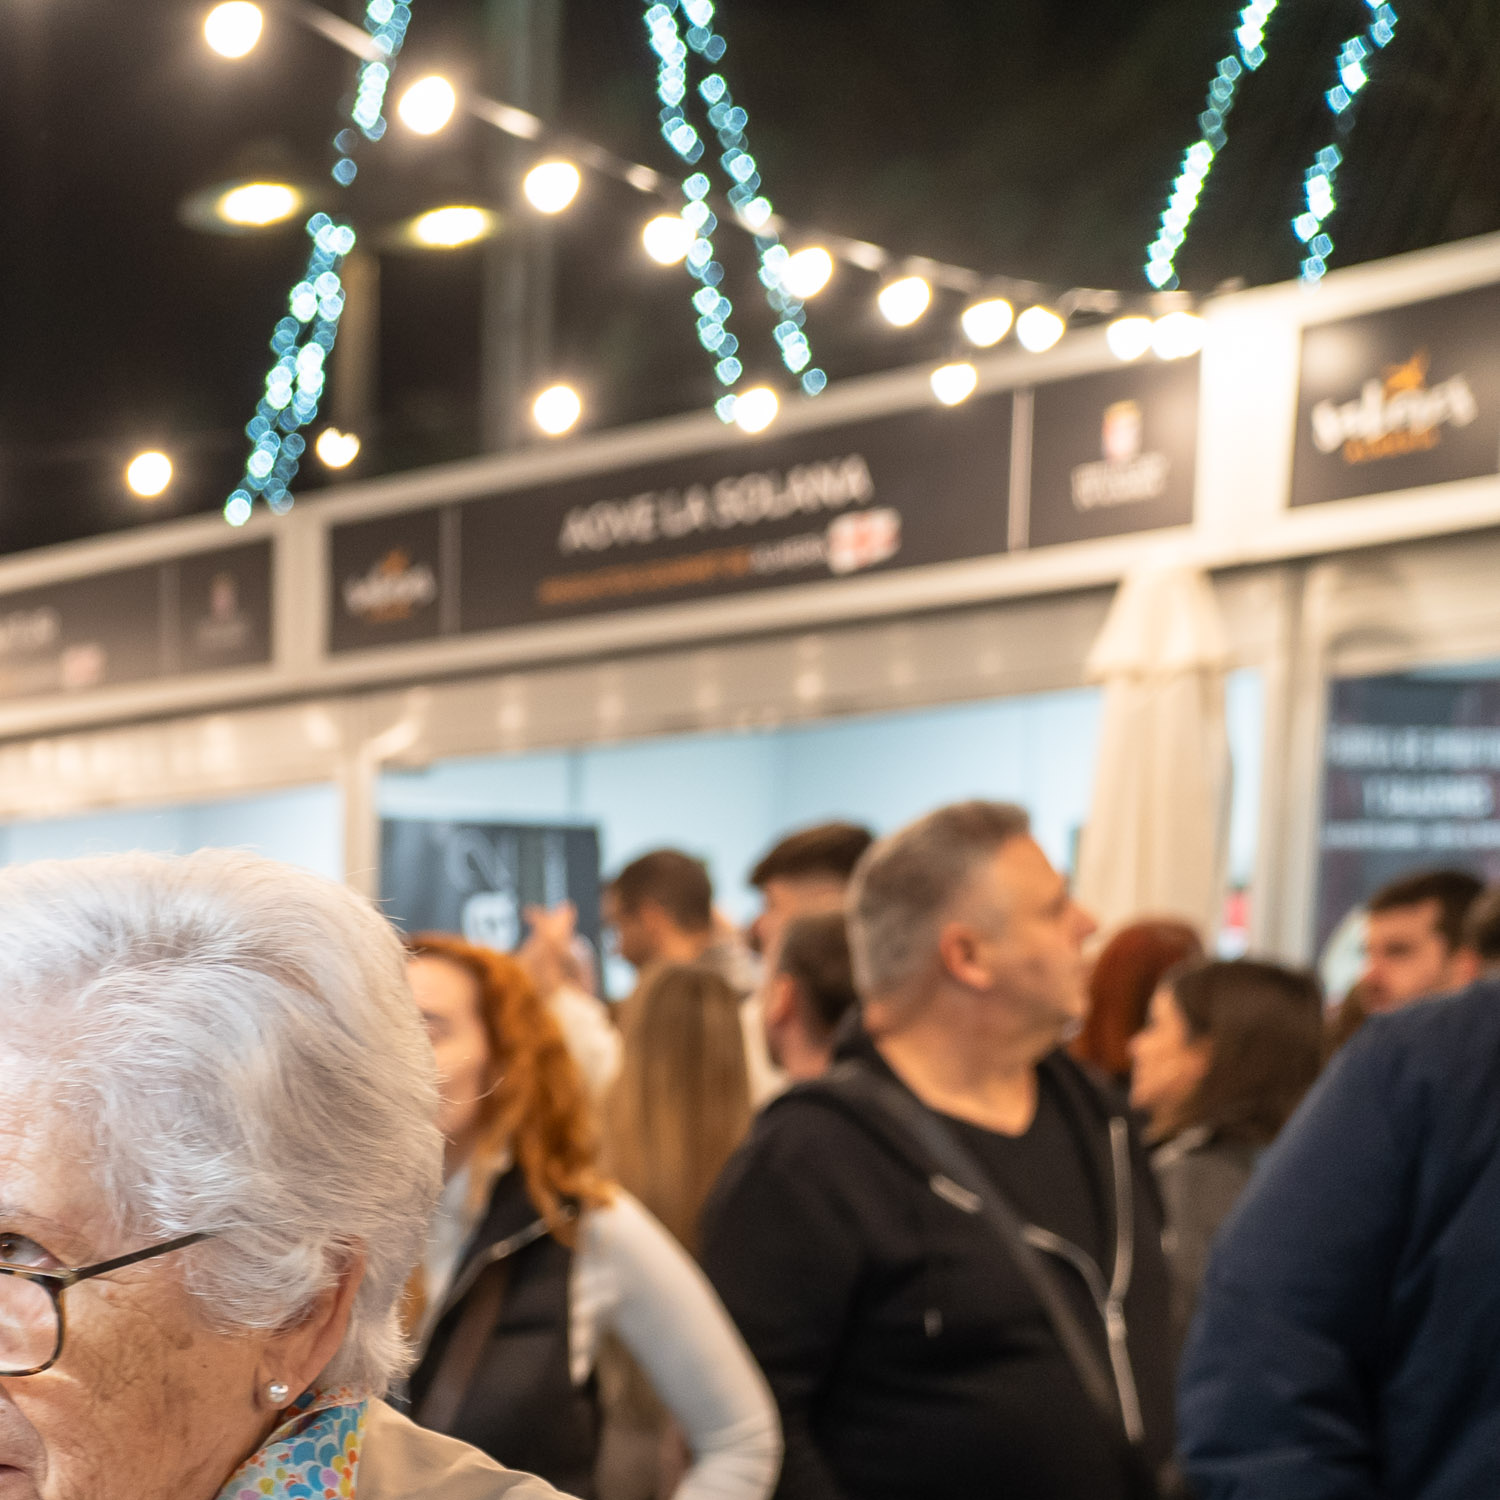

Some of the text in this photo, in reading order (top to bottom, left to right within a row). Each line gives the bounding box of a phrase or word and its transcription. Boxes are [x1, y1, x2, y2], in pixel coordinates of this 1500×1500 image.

[560, 453, 874, 556] AOVE LA SOLANA
